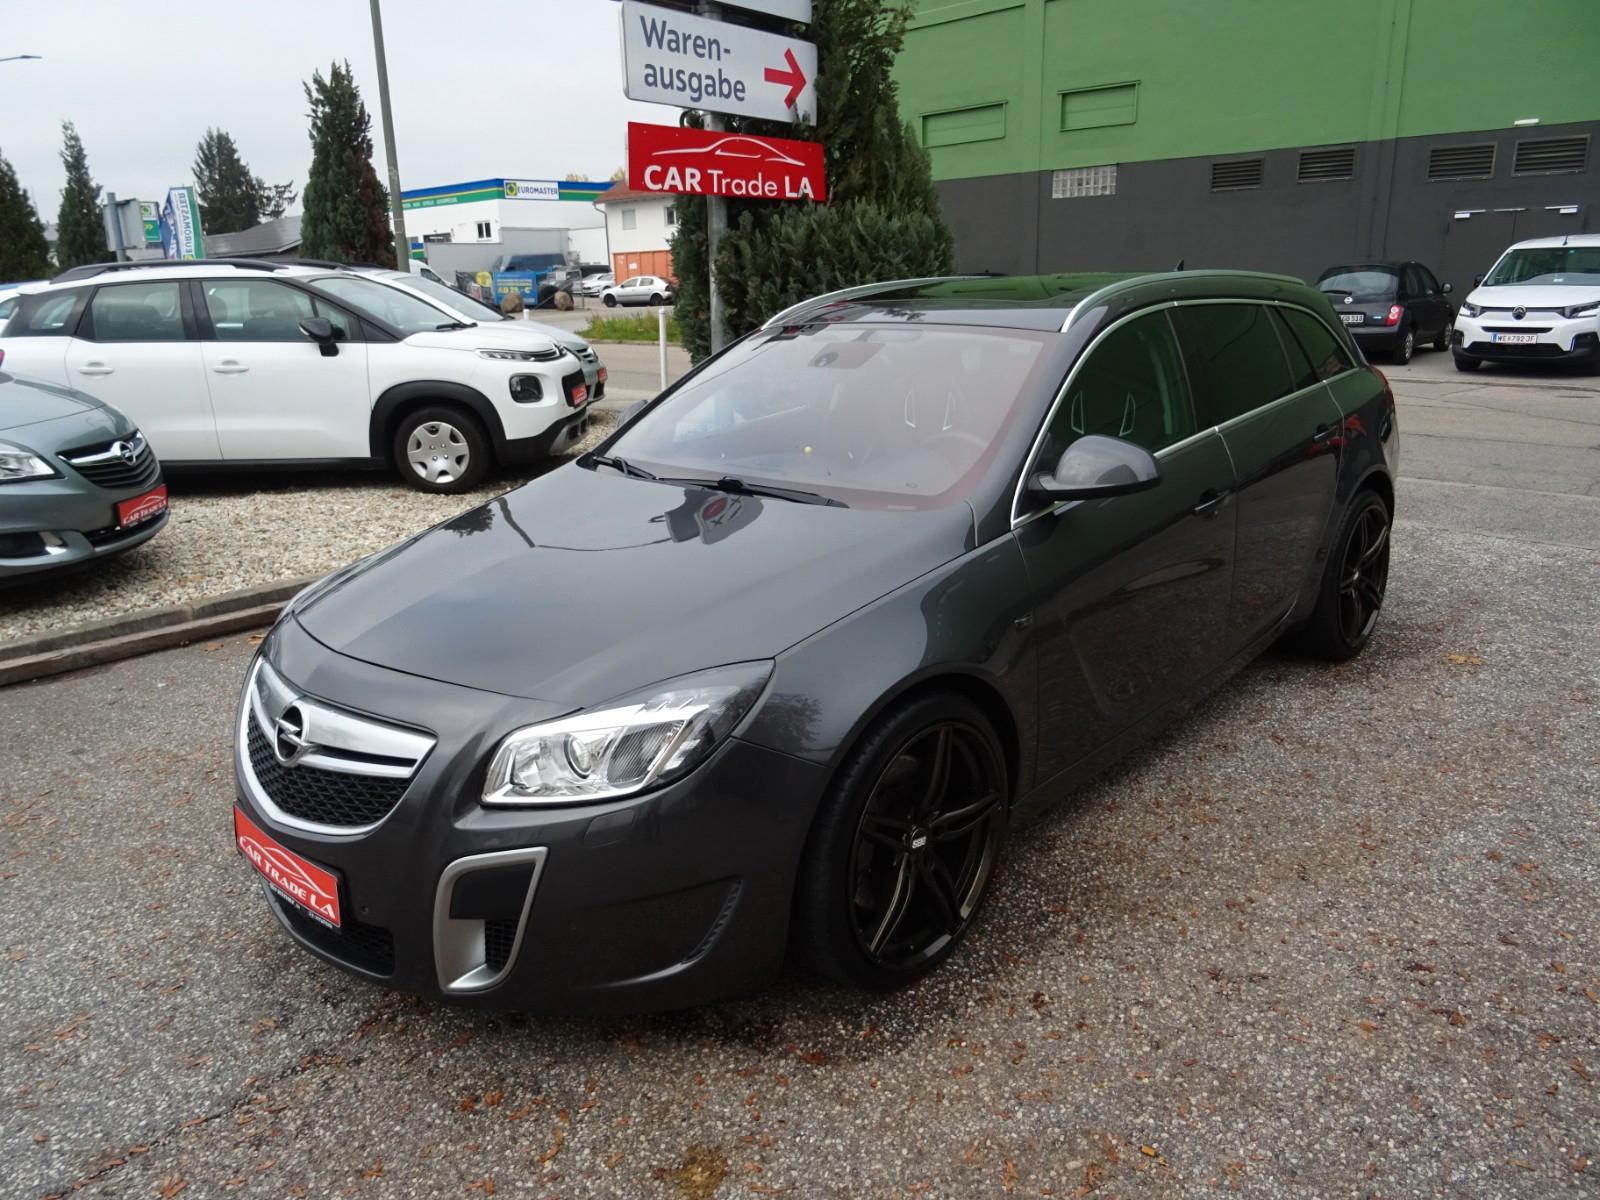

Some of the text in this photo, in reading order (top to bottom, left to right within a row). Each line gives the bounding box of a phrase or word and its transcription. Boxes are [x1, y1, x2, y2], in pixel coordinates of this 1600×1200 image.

[640, 15, 731, 61] Waren-
[644, 63, 746, 102] ausgabe
[517, 186, 558, 195] EUROMASTER
[644, 165, 815, 198] CAR Trade LA
[240, 836, 262, 867] CAR
[264, 859, 308, 901] TRADE
[310, 893, 336, 919] LA
